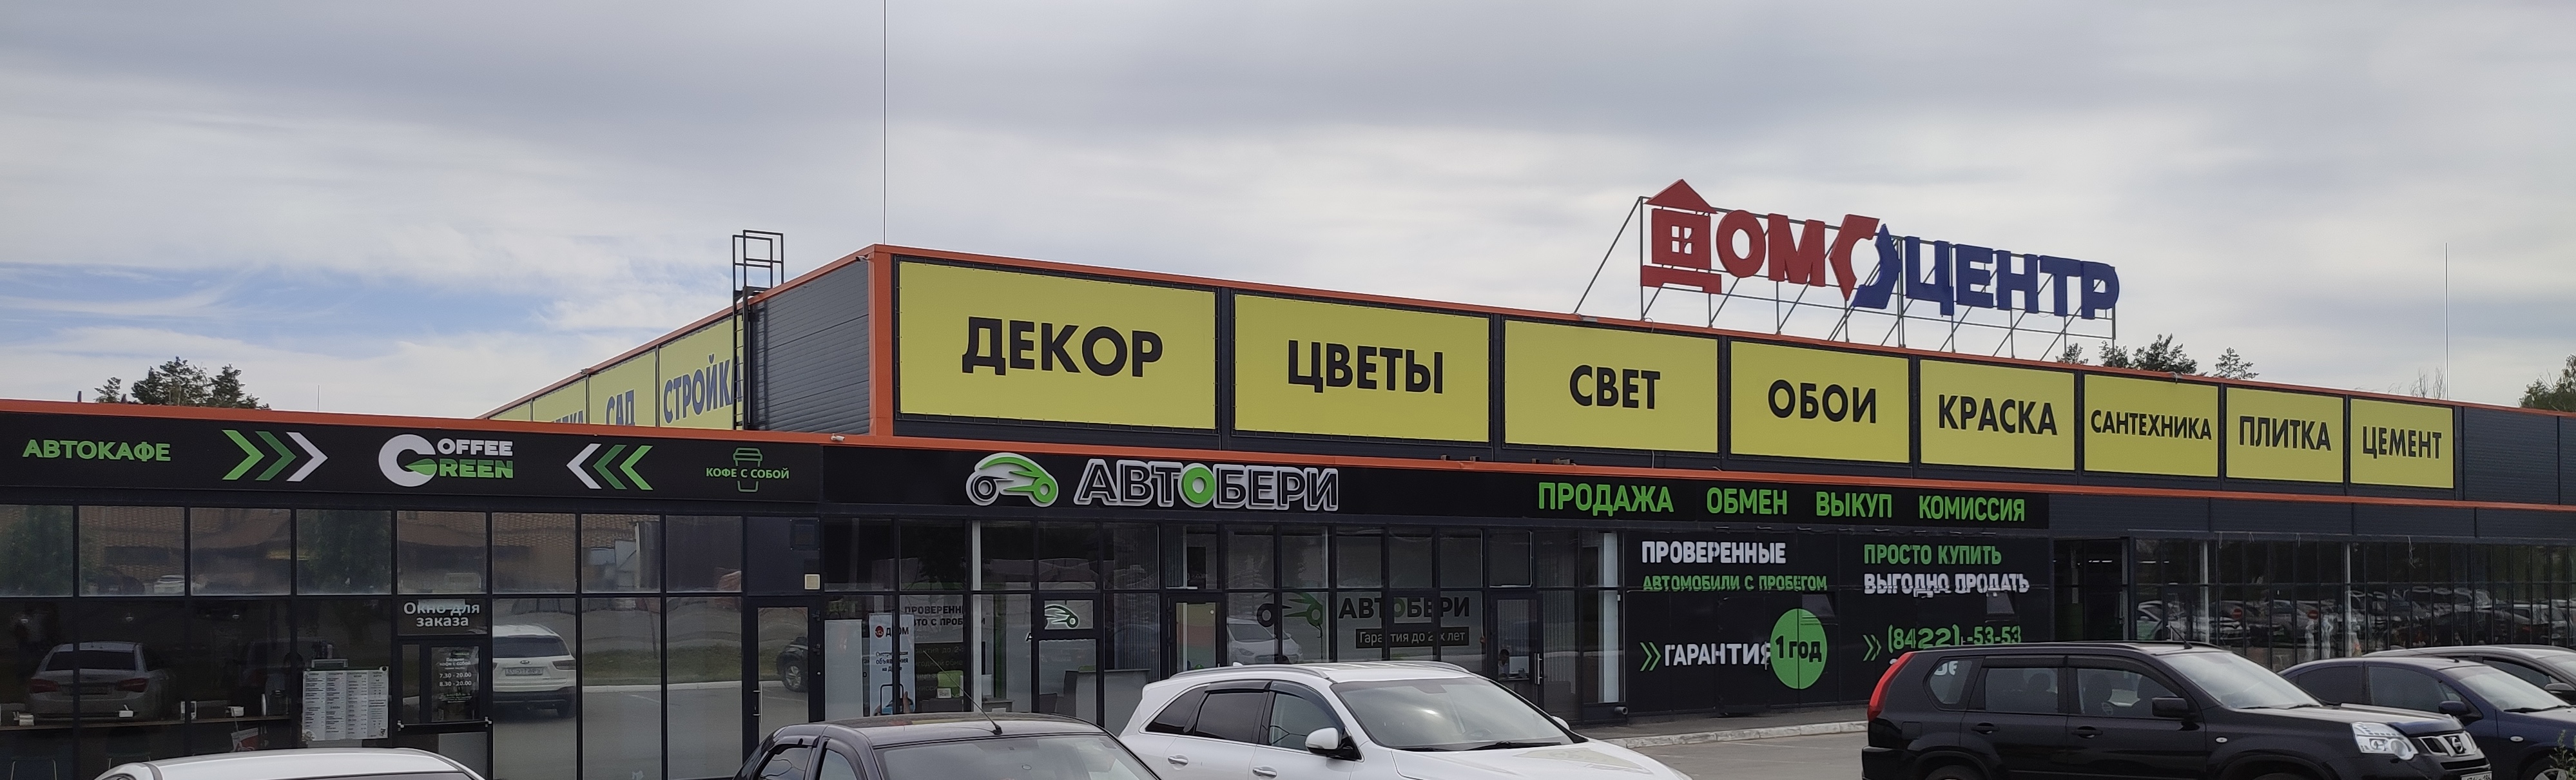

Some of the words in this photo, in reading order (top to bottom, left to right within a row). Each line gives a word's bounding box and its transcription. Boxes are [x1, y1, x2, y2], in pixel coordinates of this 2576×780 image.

[962, 317, 1164, 378] ДЕКОР
[1288, 340, 1444, 395] ЦВЕТЫ
[663, 354, 742, 424] СТРОЙКА
[1570, 365, 1661, 411] СВЕТ
[1768, 380, 1877, 425] ОБОИ
[606, 389, 635, 425] САД
[1939, 395, 2058, 436] КРАСКА
[2091, 410, 2213, 441] САНТЕХНИКА
[2240, 416, 2332, 452] ПЛИТКА
[23, 440, 171, 463] АВТОКАФЕ
[2363, 427, 2443, 460] ЦЕМЕНТ
[706, 467, 737, 478] КОФЕ
[740, 469, 748, 478] С
[750, 467, 789, 479] СОБОЙ
[1074, 458, 1339, 512] АВТОБЕРИ
[1538, 482, 1674, 517] ПРОДАЖА
[1707, 487, 1788, 515] ОБМЕН
[1816, 491, 1893, 518] ВЫКУП
[1919, 495, 2026, 522] КОМИССИЯ
[1642, 541, 1787, 563] ПРОВЕРЕННЫЕ
[1864, 544, 1932, 565] ПРОСТО
[1938, 545, 2002, 565] КУПИТЬ
[1643, 575, 1739, 590] АВТОМОБИЛИ
[1744, 576, 1754, 590] С
[1758, 575, 1828, 591] ПРОБЕГОМ
[1864, 573, 1951, 598] ВЫГОДНО
[1955, 573, 2030, 597] ПРОДАТЬ
[403, 602, 445, 614] Окно
[450, 604, 480, 616] для
[416, 617, 469, 627] заказа
[904, 605, 964, 614] ПРОВЕРЕНН
[1360, 632, 1408, 646] Гаратия
[1411, 633, 1425, 643] до
[1448, 632, 1466, 641] лет
[1665, 643, 1771, 666] ГАРАНТИЯ
[1775, 635, 1784, 659] 1
[1788, 641, 1822, 663] год
